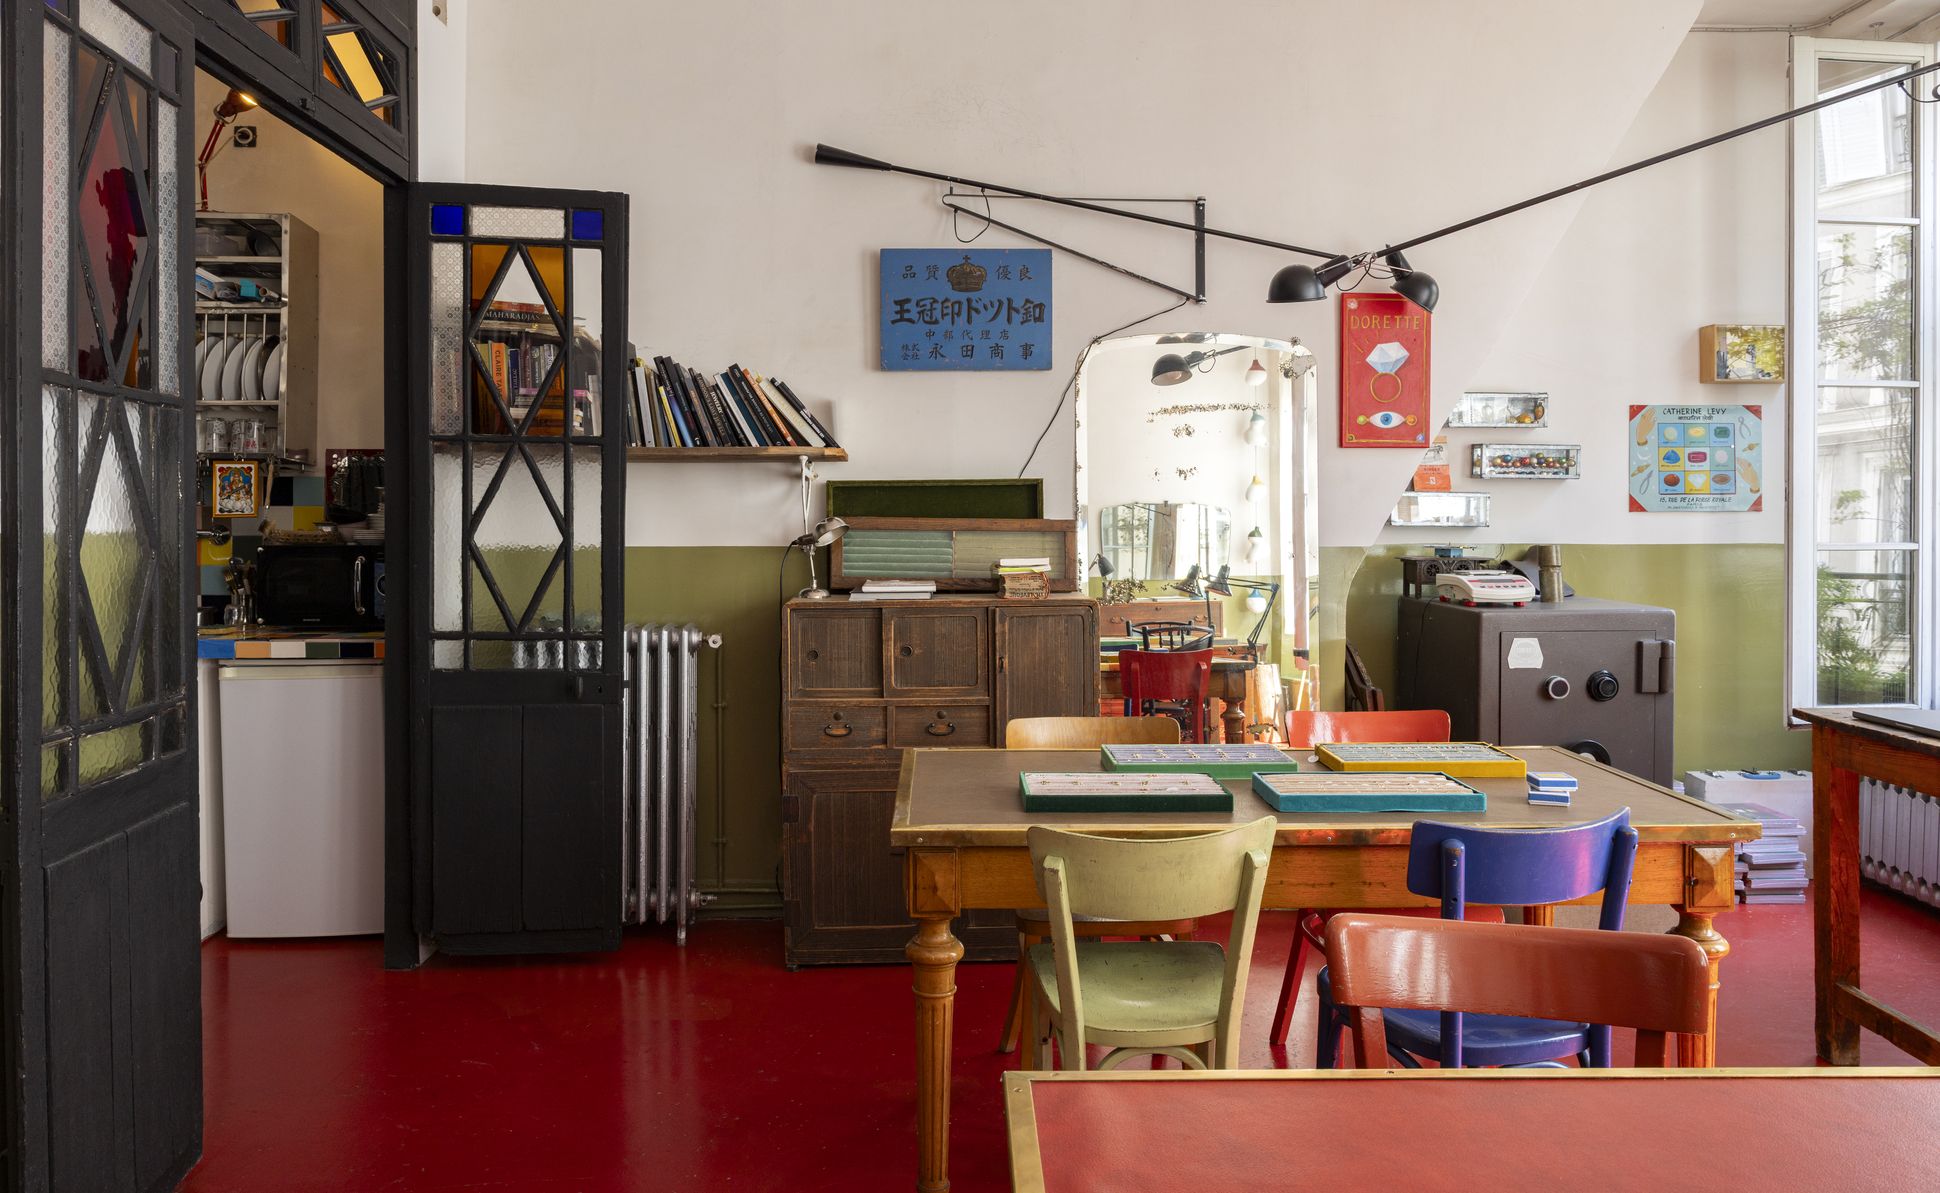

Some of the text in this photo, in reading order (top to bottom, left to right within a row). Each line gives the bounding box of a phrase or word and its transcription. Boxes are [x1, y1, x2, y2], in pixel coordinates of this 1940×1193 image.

[996, 264, 1033, 281] 優良
[1350, 315, 1421, 330] DORETTE
[1662, 407, 1727, 416] CATHERINE LEVY
